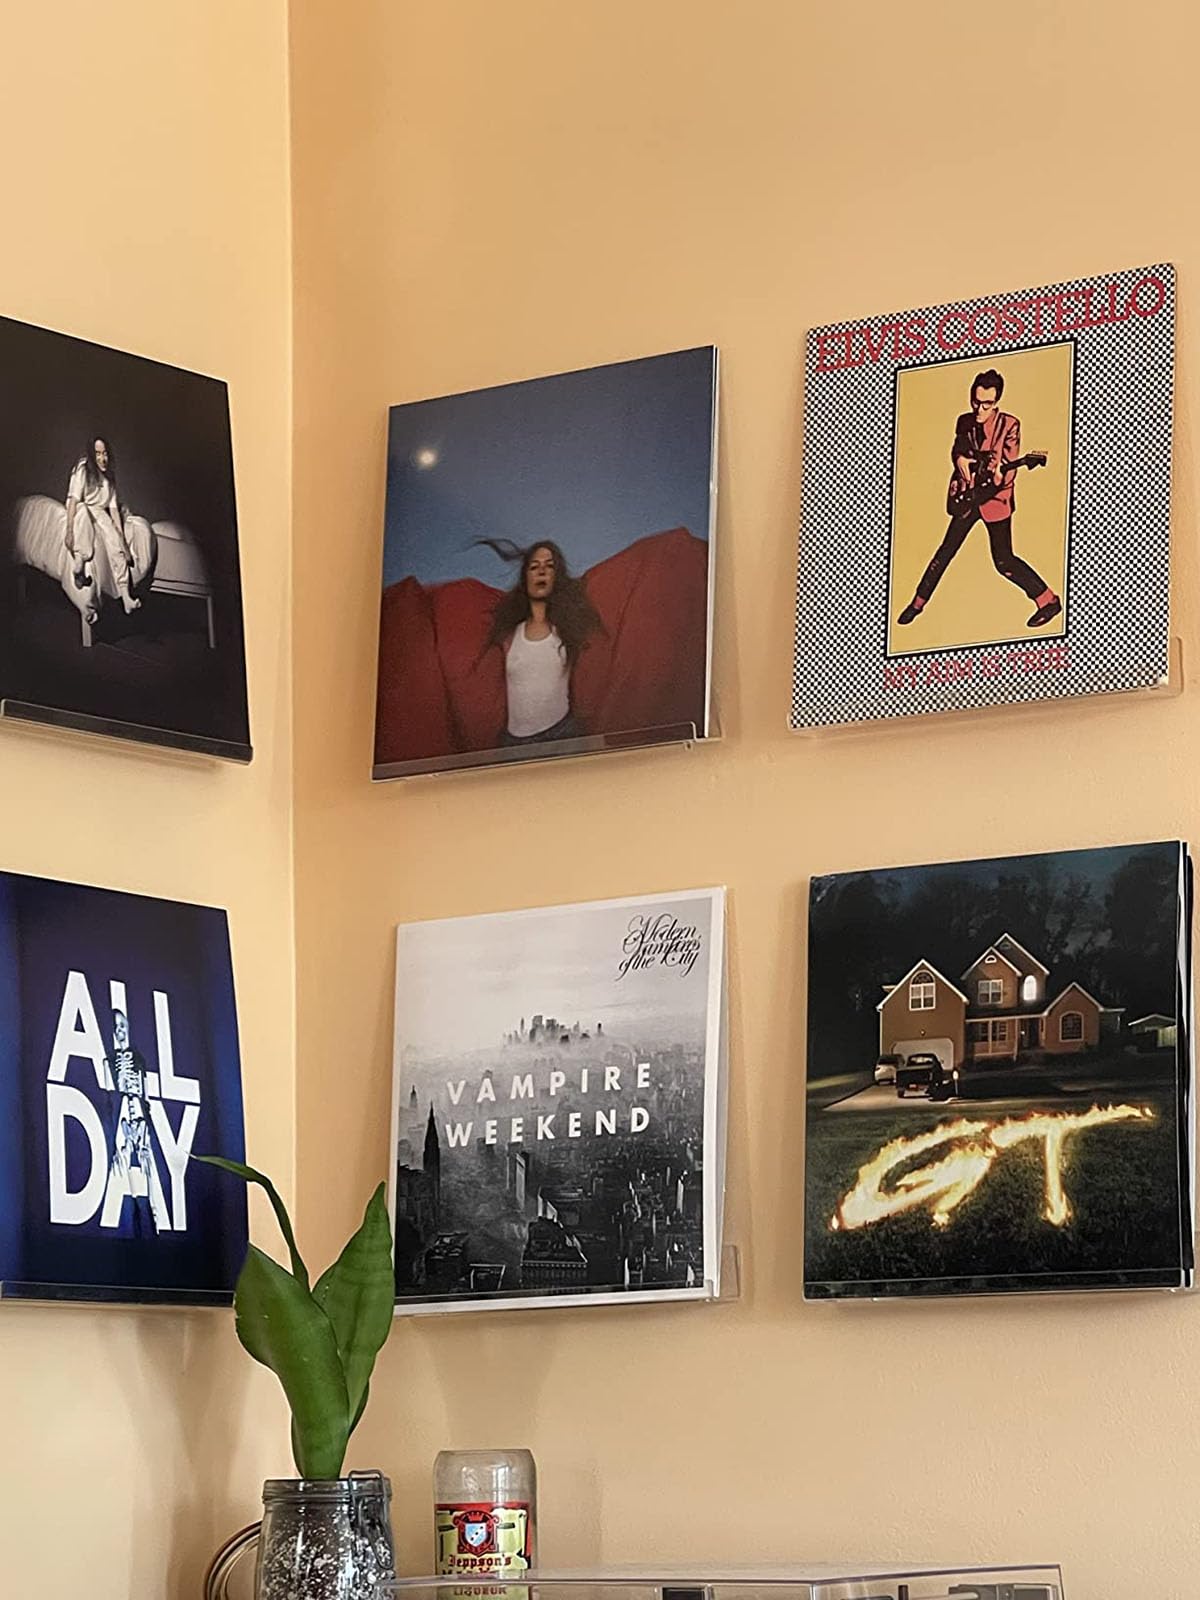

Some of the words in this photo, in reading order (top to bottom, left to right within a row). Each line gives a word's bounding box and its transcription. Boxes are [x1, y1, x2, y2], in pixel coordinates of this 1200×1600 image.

[814, 318, 926, 373] ELVIS
[937, 276, 1165, 351] COSTELLO
[46, 970, 201, 1104] ALL
[446, 1062, 651, 1105] VAMPIRE
[46, 1082, 201, 1234] DAY
[445, 1106, 650, 1148] WEEKEND
[454, 1586, 507, 1596] LIQUEUR
